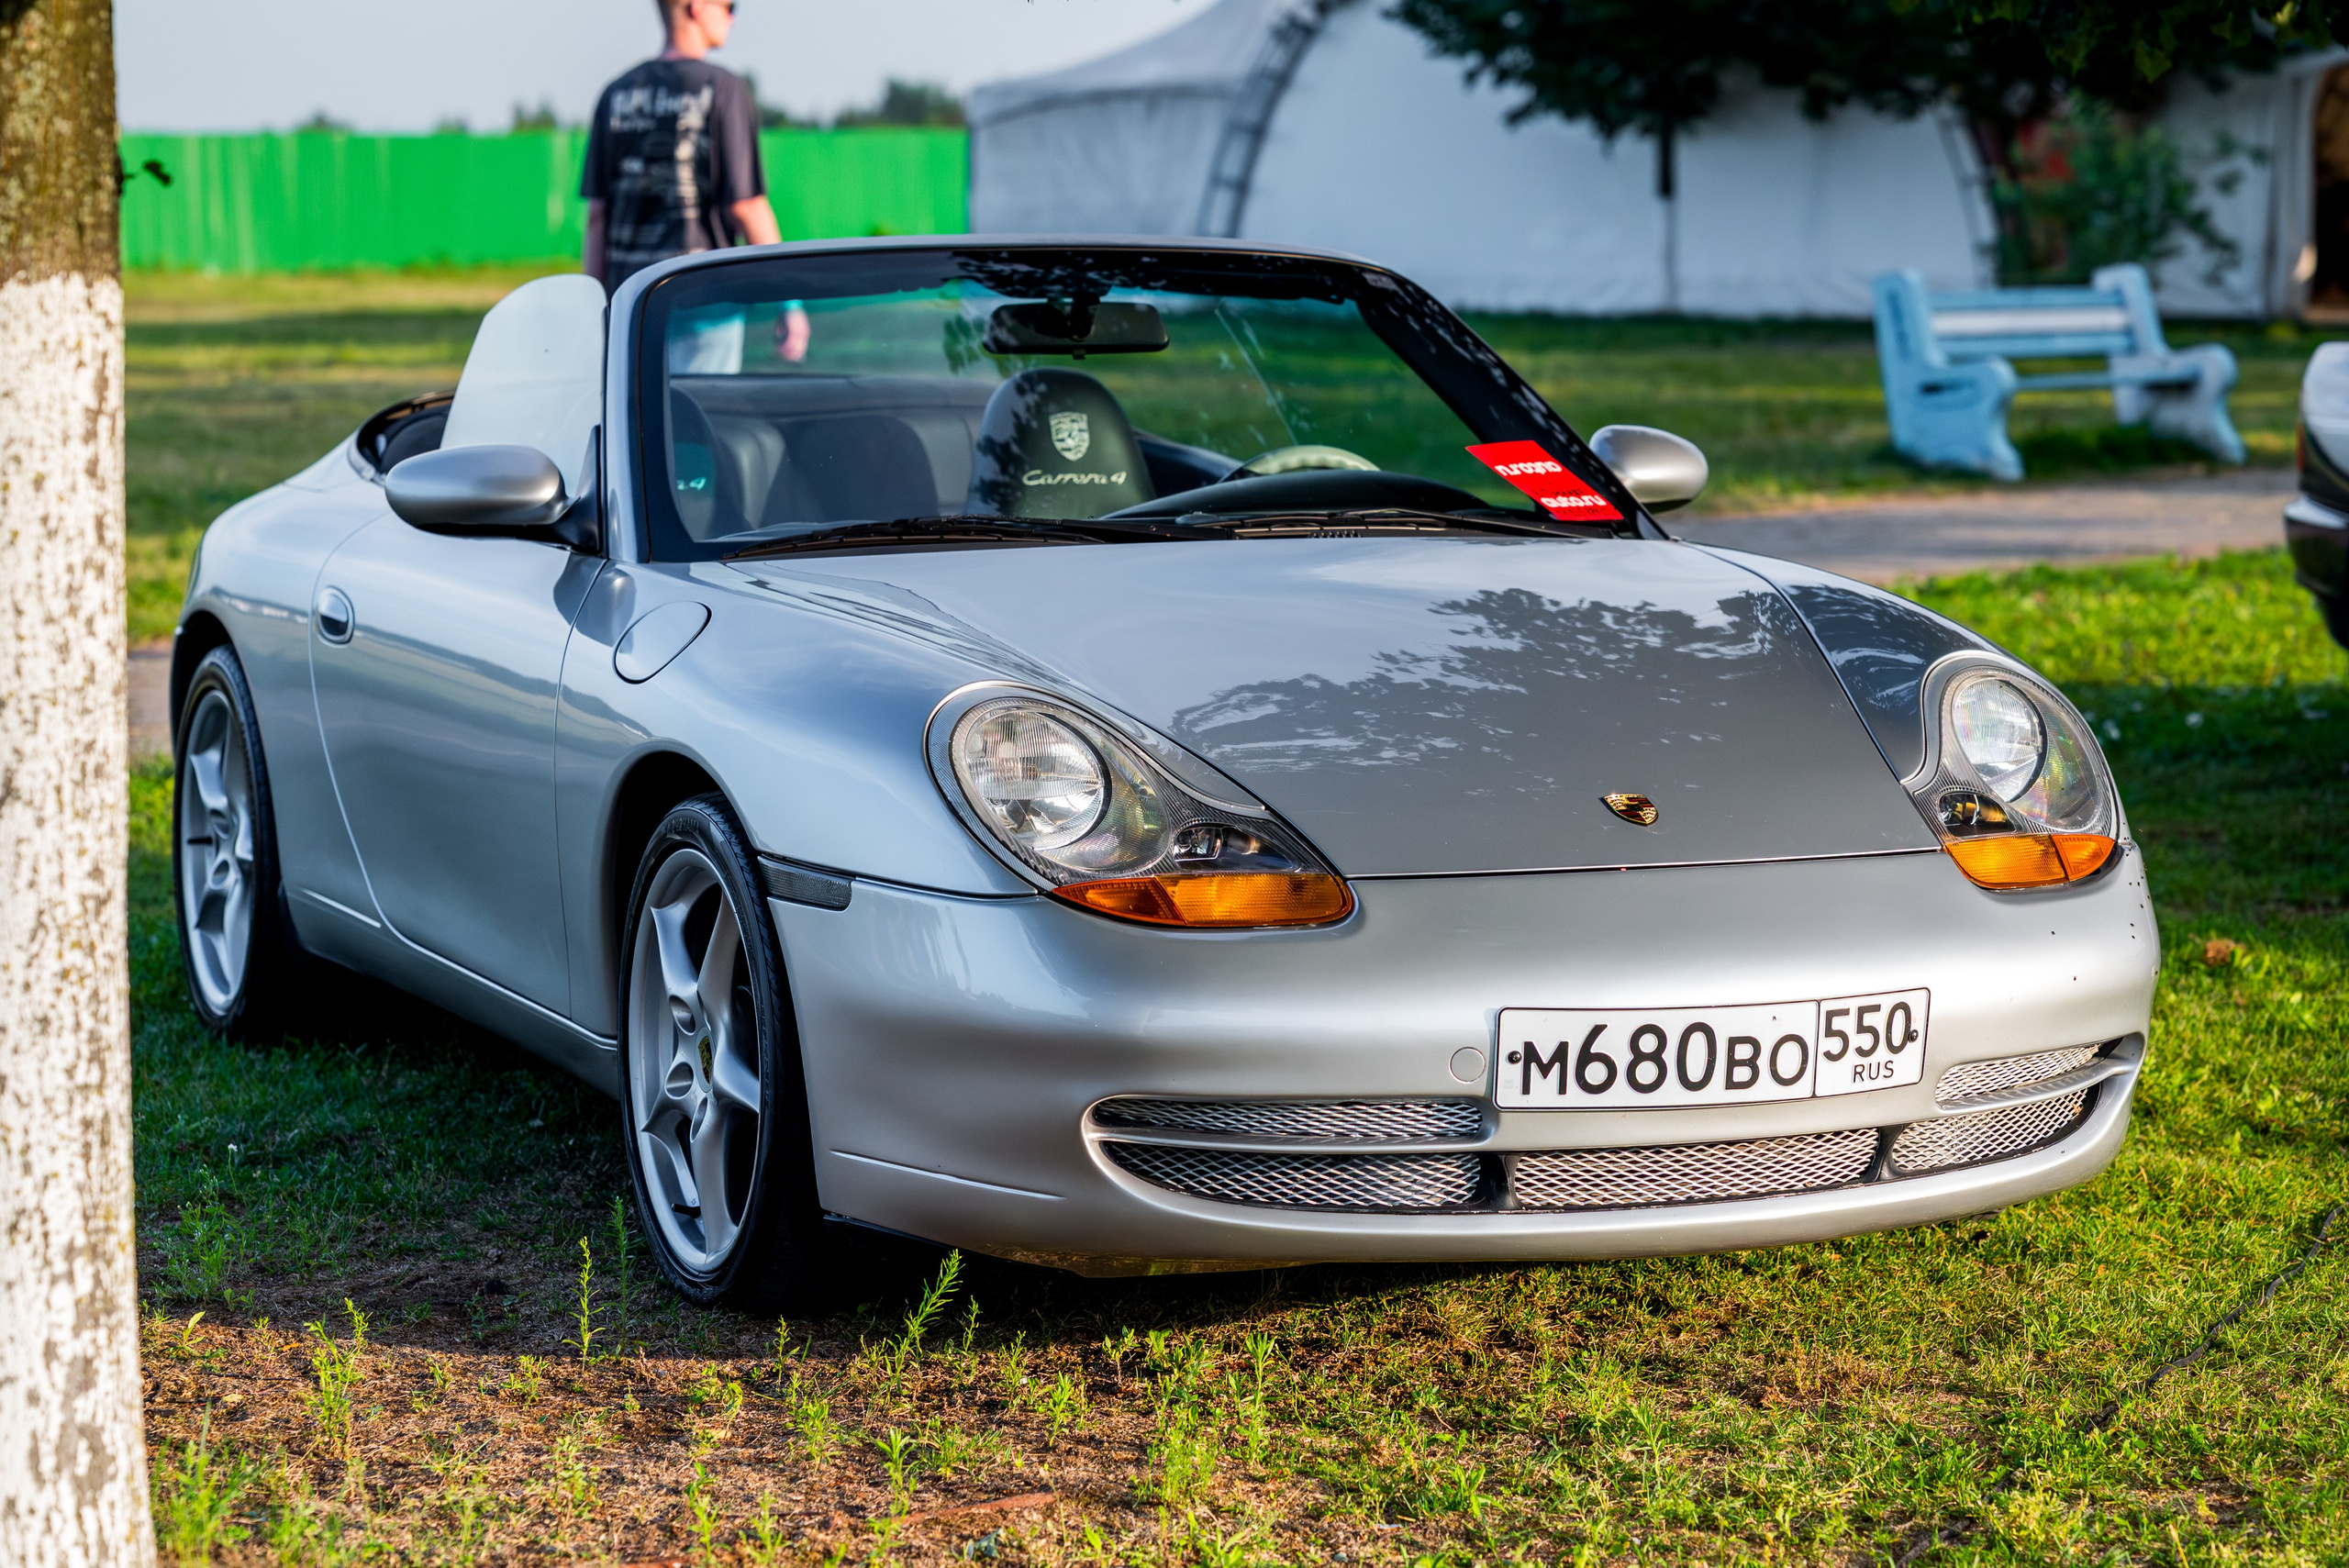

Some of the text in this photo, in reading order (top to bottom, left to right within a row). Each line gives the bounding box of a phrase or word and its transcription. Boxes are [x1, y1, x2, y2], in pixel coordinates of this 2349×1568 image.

[1022, 469, 1128, 486] Carrera 4
[1540, 495, 1609, 509] auto.ru
[1822, 1001, 1913, 1062] 550
[1853, 1060, 1896, 1084] RUS
